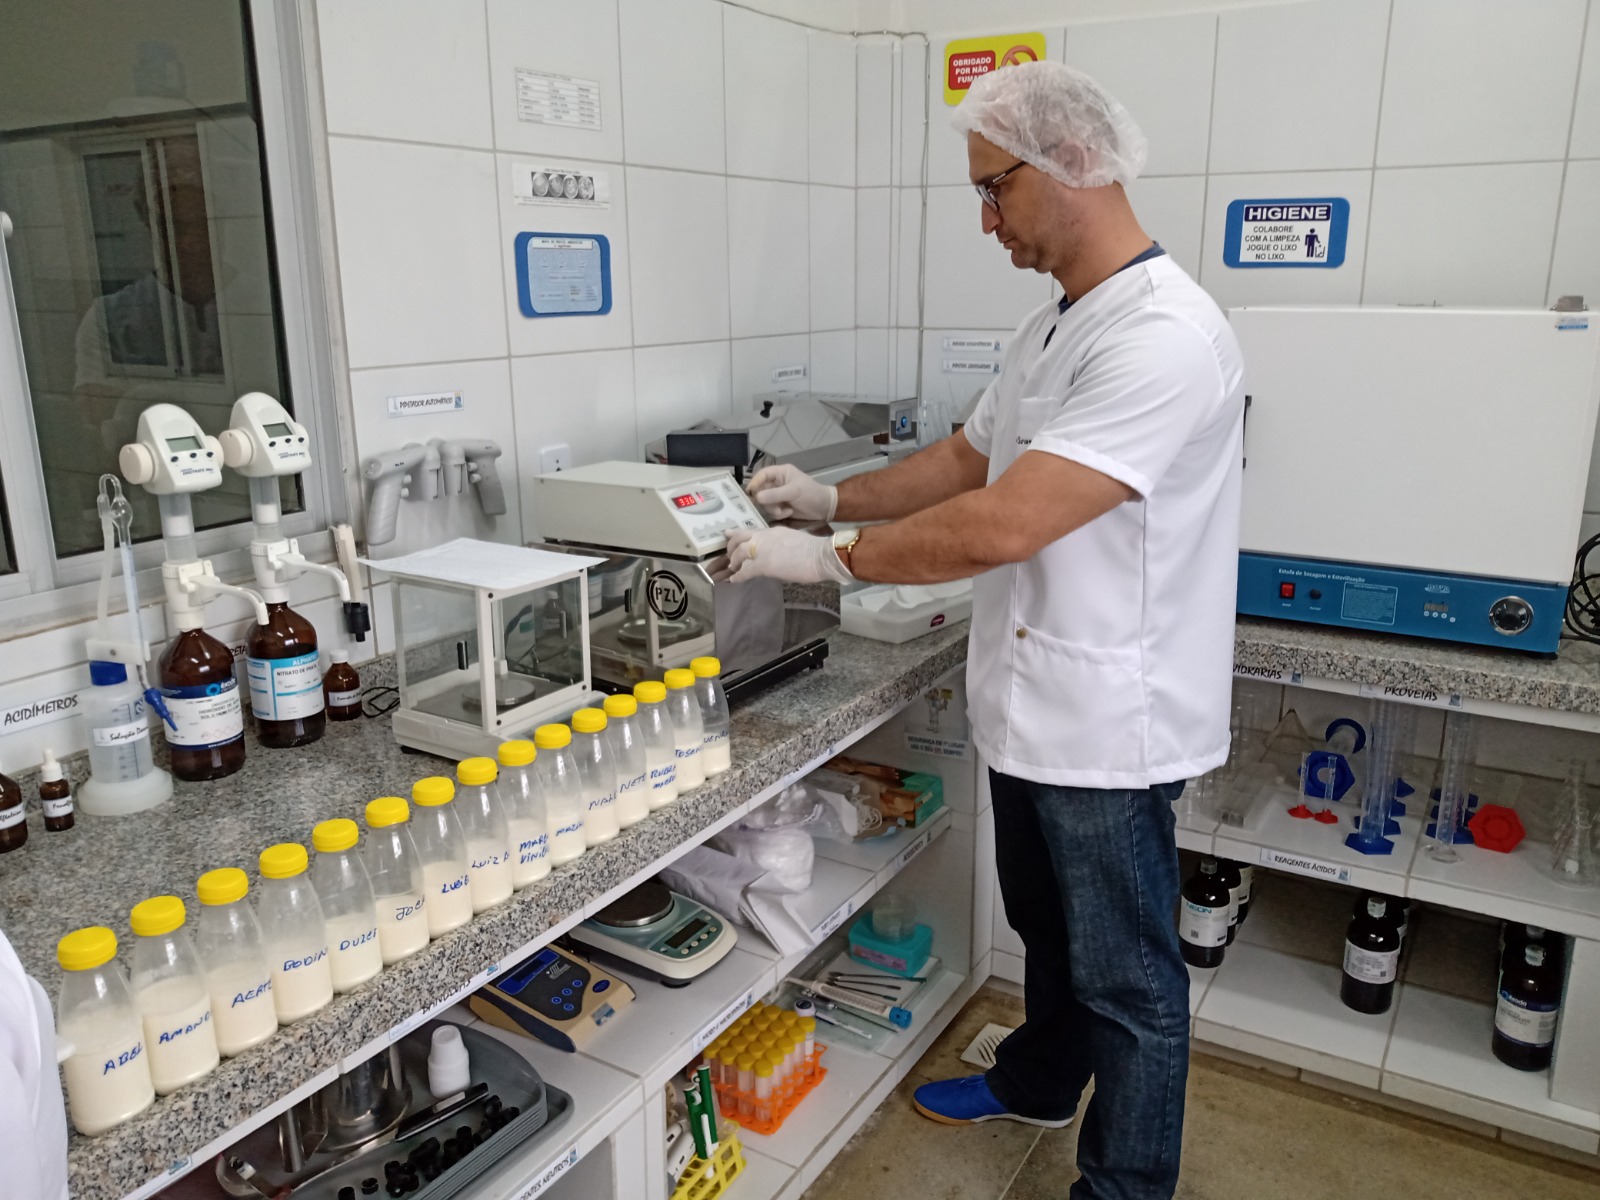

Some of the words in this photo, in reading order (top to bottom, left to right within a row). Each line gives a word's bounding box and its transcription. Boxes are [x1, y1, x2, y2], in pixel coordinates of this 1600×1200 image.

[953, 56, 991, 67] OBRIGADO
[955, 67, 971, 75] POR
[972, 65, 989, 73] NÃO
[1248, 206, 1328, 220] HIGIENE
[655, 586, 679, 604] PZL
[4, 695, 78, 727] ACIDÍMETROS
[1274, 855, 1310, 869] REAGENTES
[1311, 863, 1336, 875] ÁCIDOS
[104, 1041, 143, 1075] ABEL
